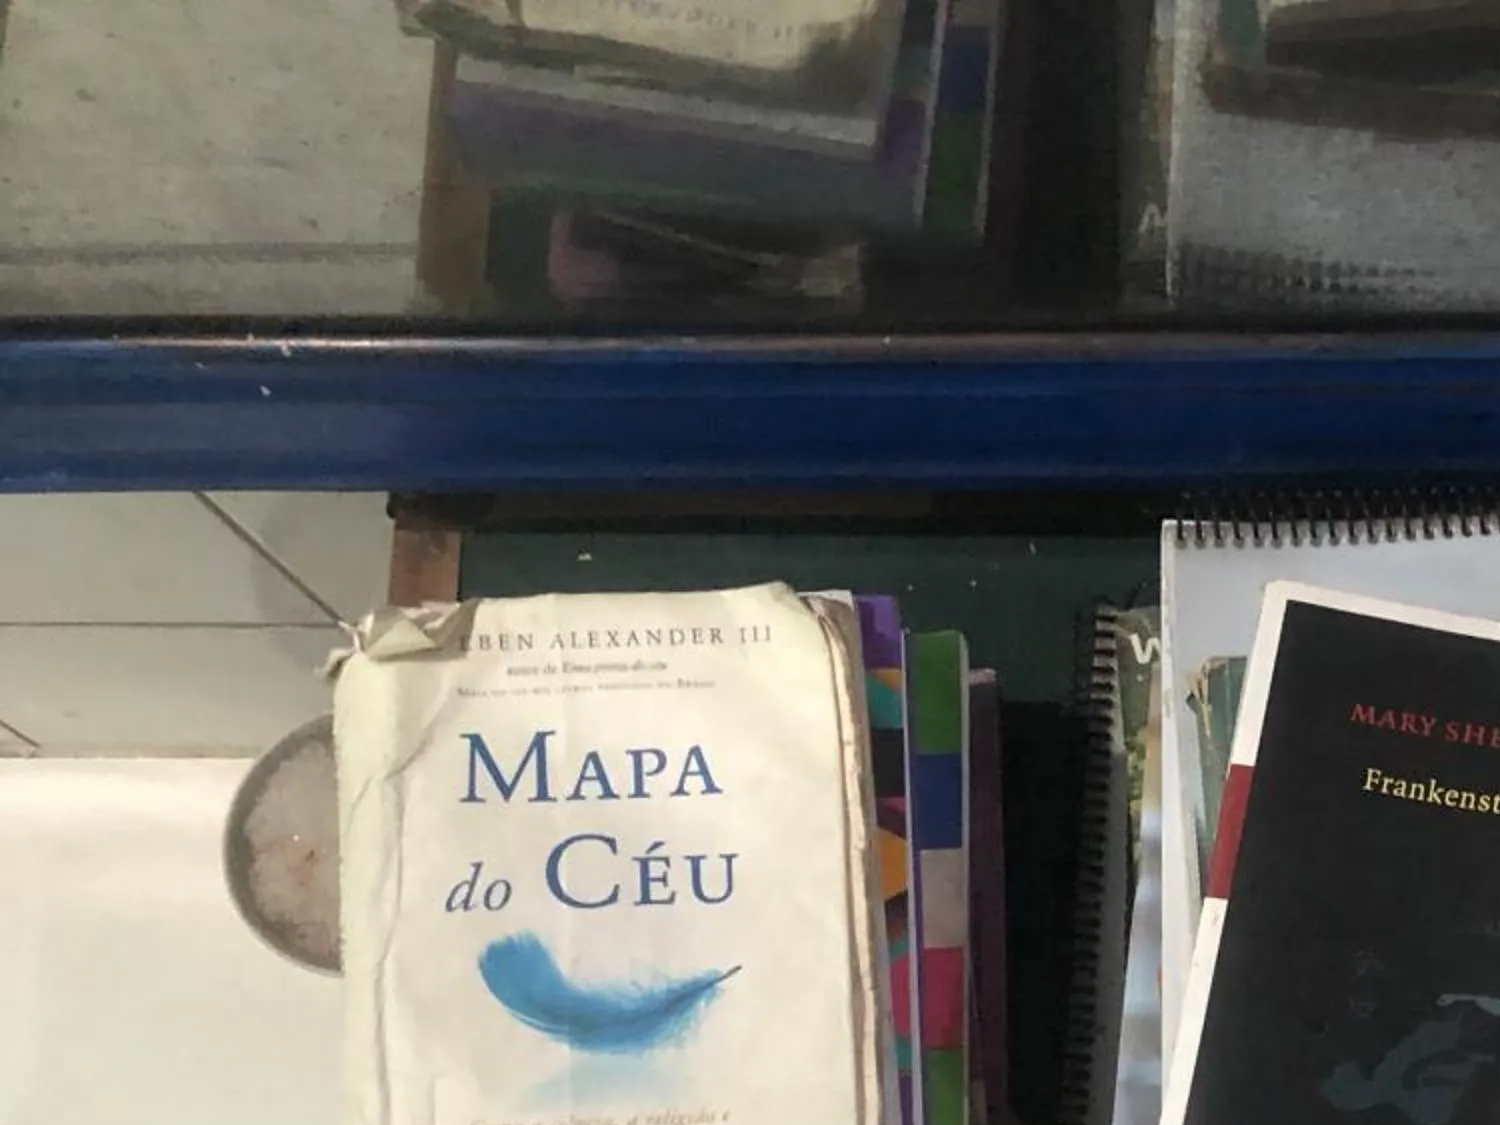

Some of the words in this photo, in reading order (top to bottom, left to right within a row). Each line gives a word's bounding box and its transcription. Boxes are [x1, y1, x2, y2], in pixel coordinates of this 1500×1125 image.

[461, 633, 534, 651] EBEN
[550, 627, 724, 650] ALEXANDER
[739, 625, 772, 644] III
[1350, 703, 1437, 736] MARY
[459, 730, 723, 803] MAPA
[445, 862, 512, 914] do
[544, 833, 738, 909] CÉU
